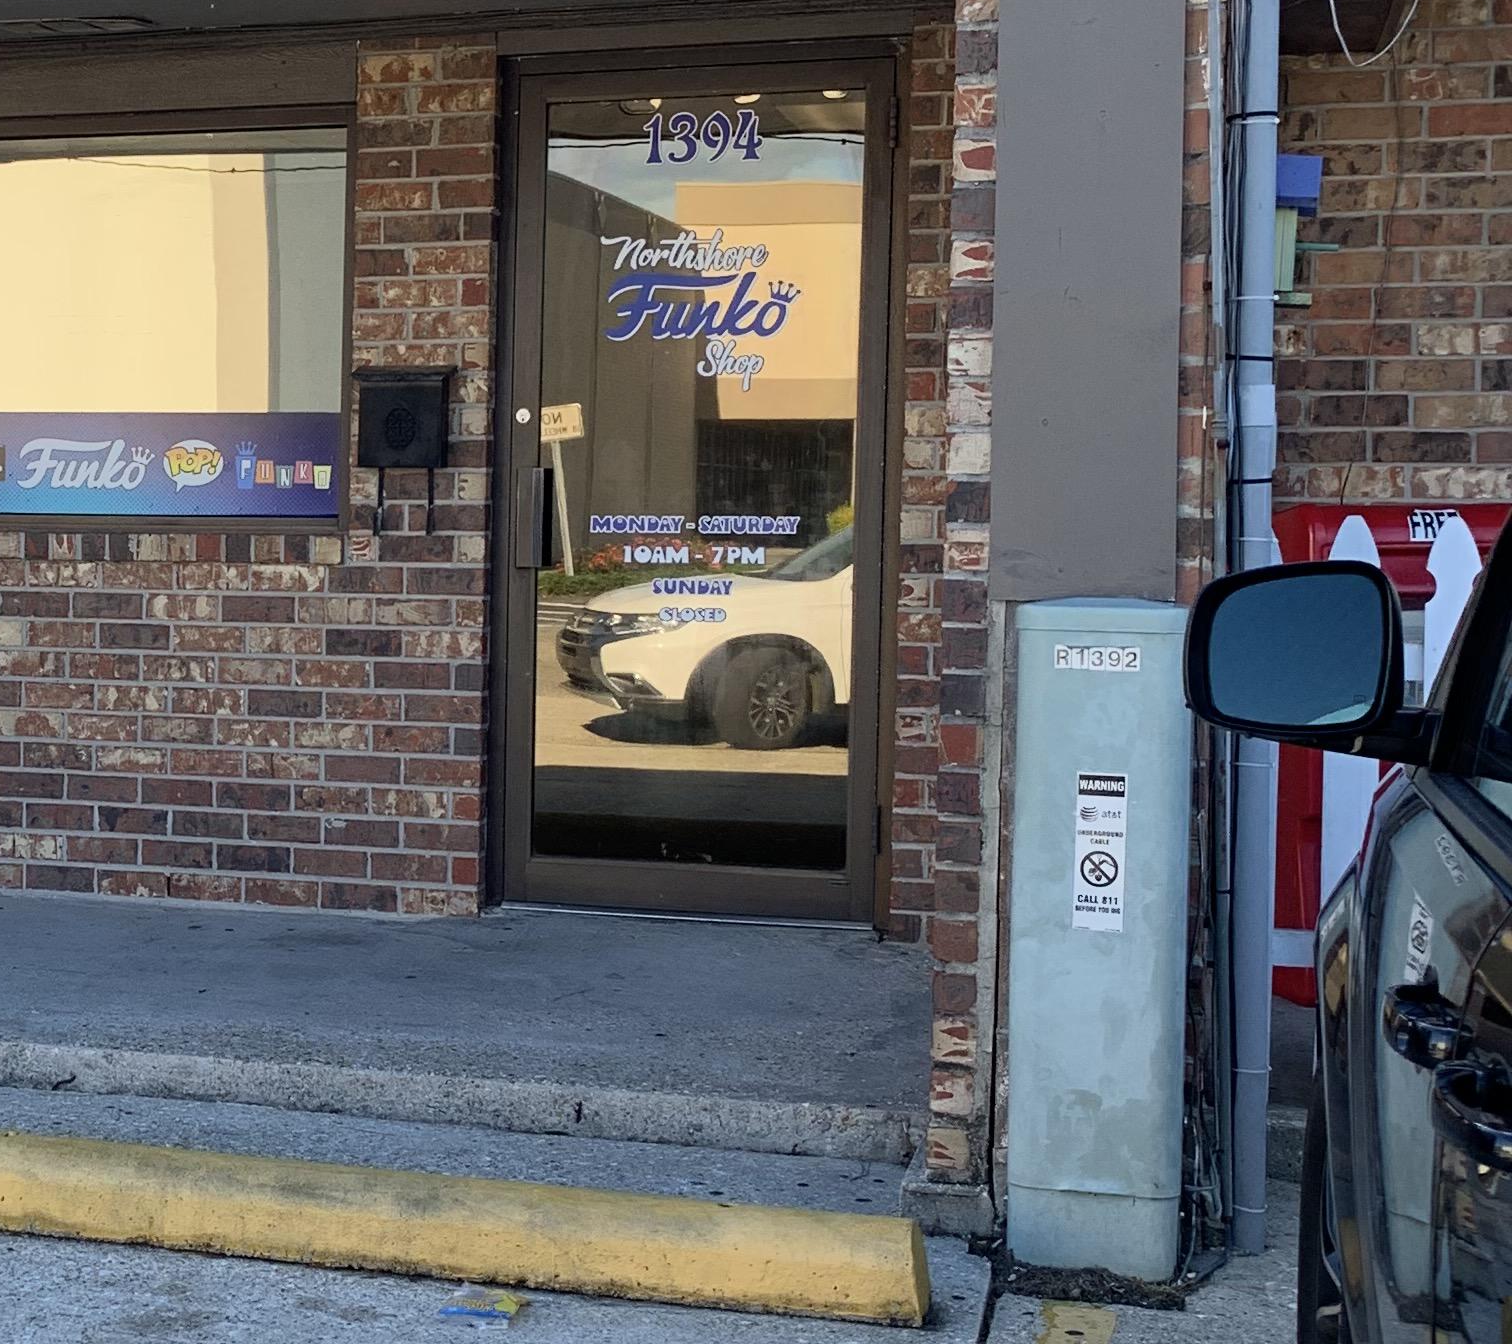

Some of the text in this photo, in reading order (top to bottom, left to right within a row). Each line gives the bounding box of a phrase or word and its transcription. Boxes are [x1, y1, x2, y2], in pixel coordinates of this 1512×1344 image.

[643, 109, 764, 165] 1394
[600, 228, 770, 272] Northshore
[606, 271, 790, 341] Funko
[696, 339, 765, 393] Shop
[17, 437, 147, 490] Funko
[164, 446, 222, 478] POP!
[237, 457, 330, 488] FUNKO
[590, 514, 685, 535] MONDAY
[698, 515, 801, 535] SATURDAY
[623, 544, 689, 565] 10AM
[652, 577, 734, 597] SUNDAY
[658, 606, 727, 623] CLOSED
[1055, 648, 1138, 669] R1392
[1079, 779, 1125, 792] WARNING
[1075, 904, 1096, 913] BEFORE
[1077, 894, 1118, 905] CALL 811
